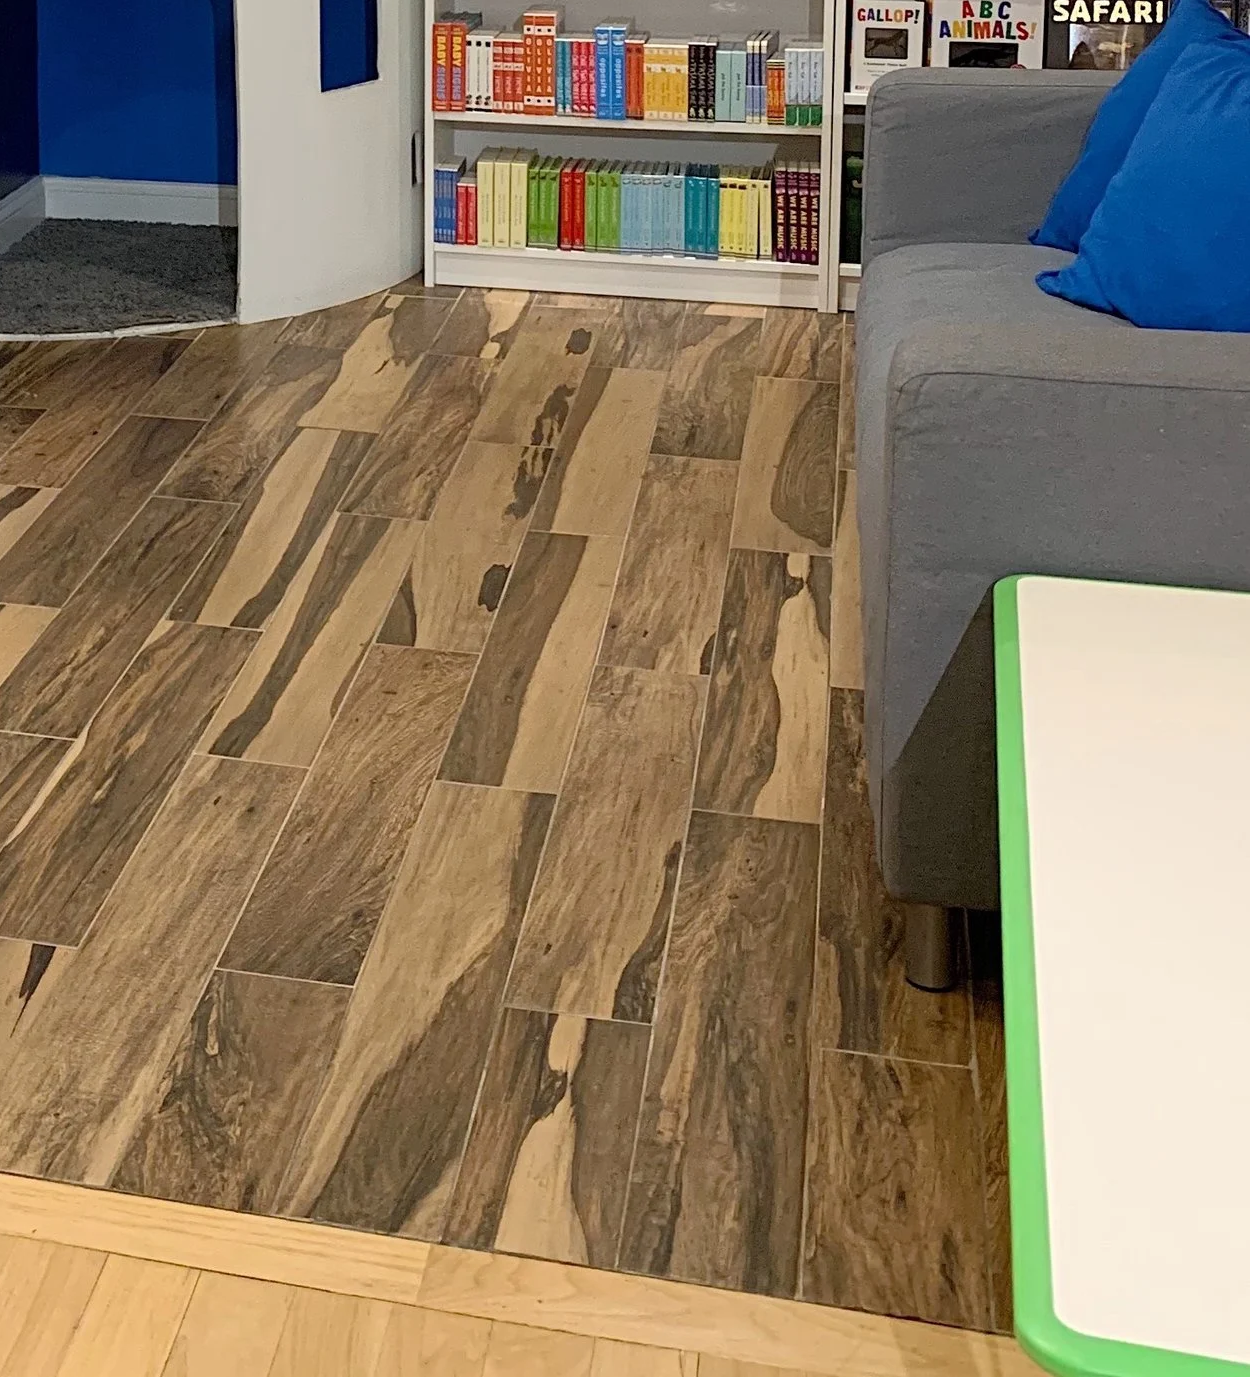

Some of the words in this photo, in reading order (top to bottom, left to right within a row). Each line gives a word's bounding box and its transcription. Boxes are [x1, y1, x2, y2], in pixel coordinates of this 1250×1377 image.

[857, 8, 920, 24] GALLOP!
[938, 19, 1037, 40] ANIMALS!
[437, 35, 446, 66] BABY
[452, 36, 462, 67] BABY
[777, 225, 785, 249] MUSIC
